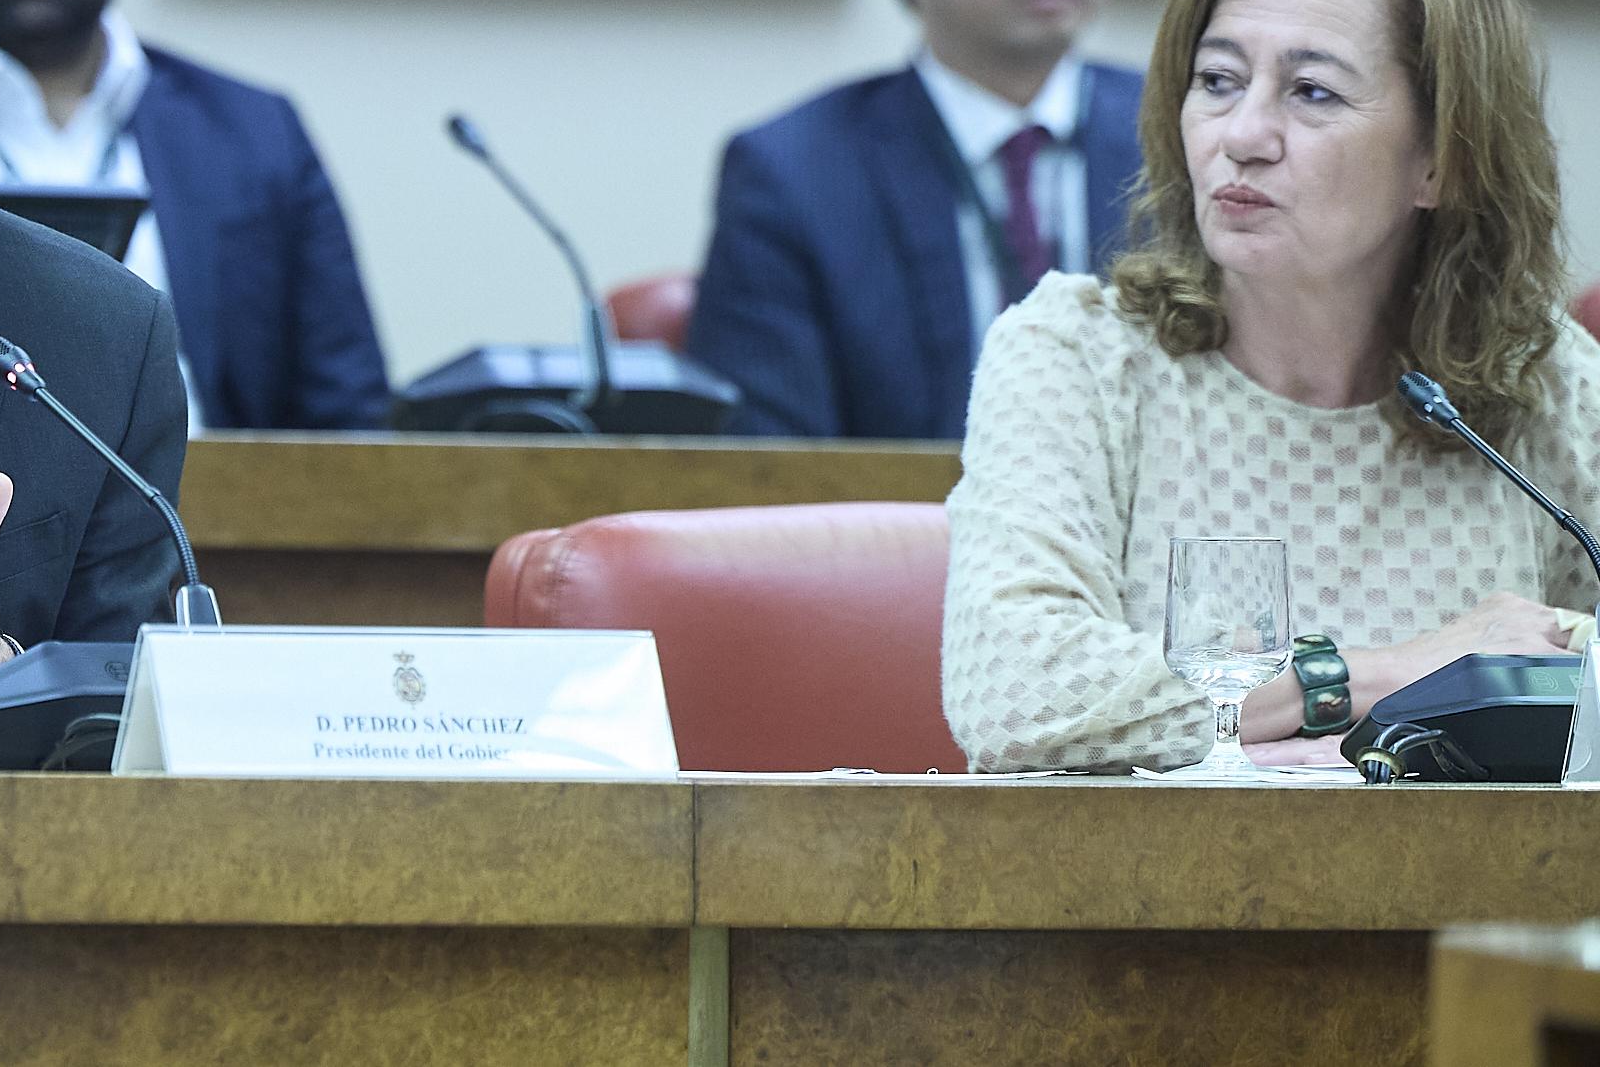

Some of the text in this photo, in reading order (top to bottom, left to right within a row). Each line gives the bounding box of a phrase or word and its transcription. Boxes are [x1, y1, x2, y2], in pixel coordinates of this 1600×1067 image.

[315, 711, 527, 734] D. PEDRO SÁNCHEZ
[313, 742, 410, 759] Presidente
[415, 743, 443, 759] del
